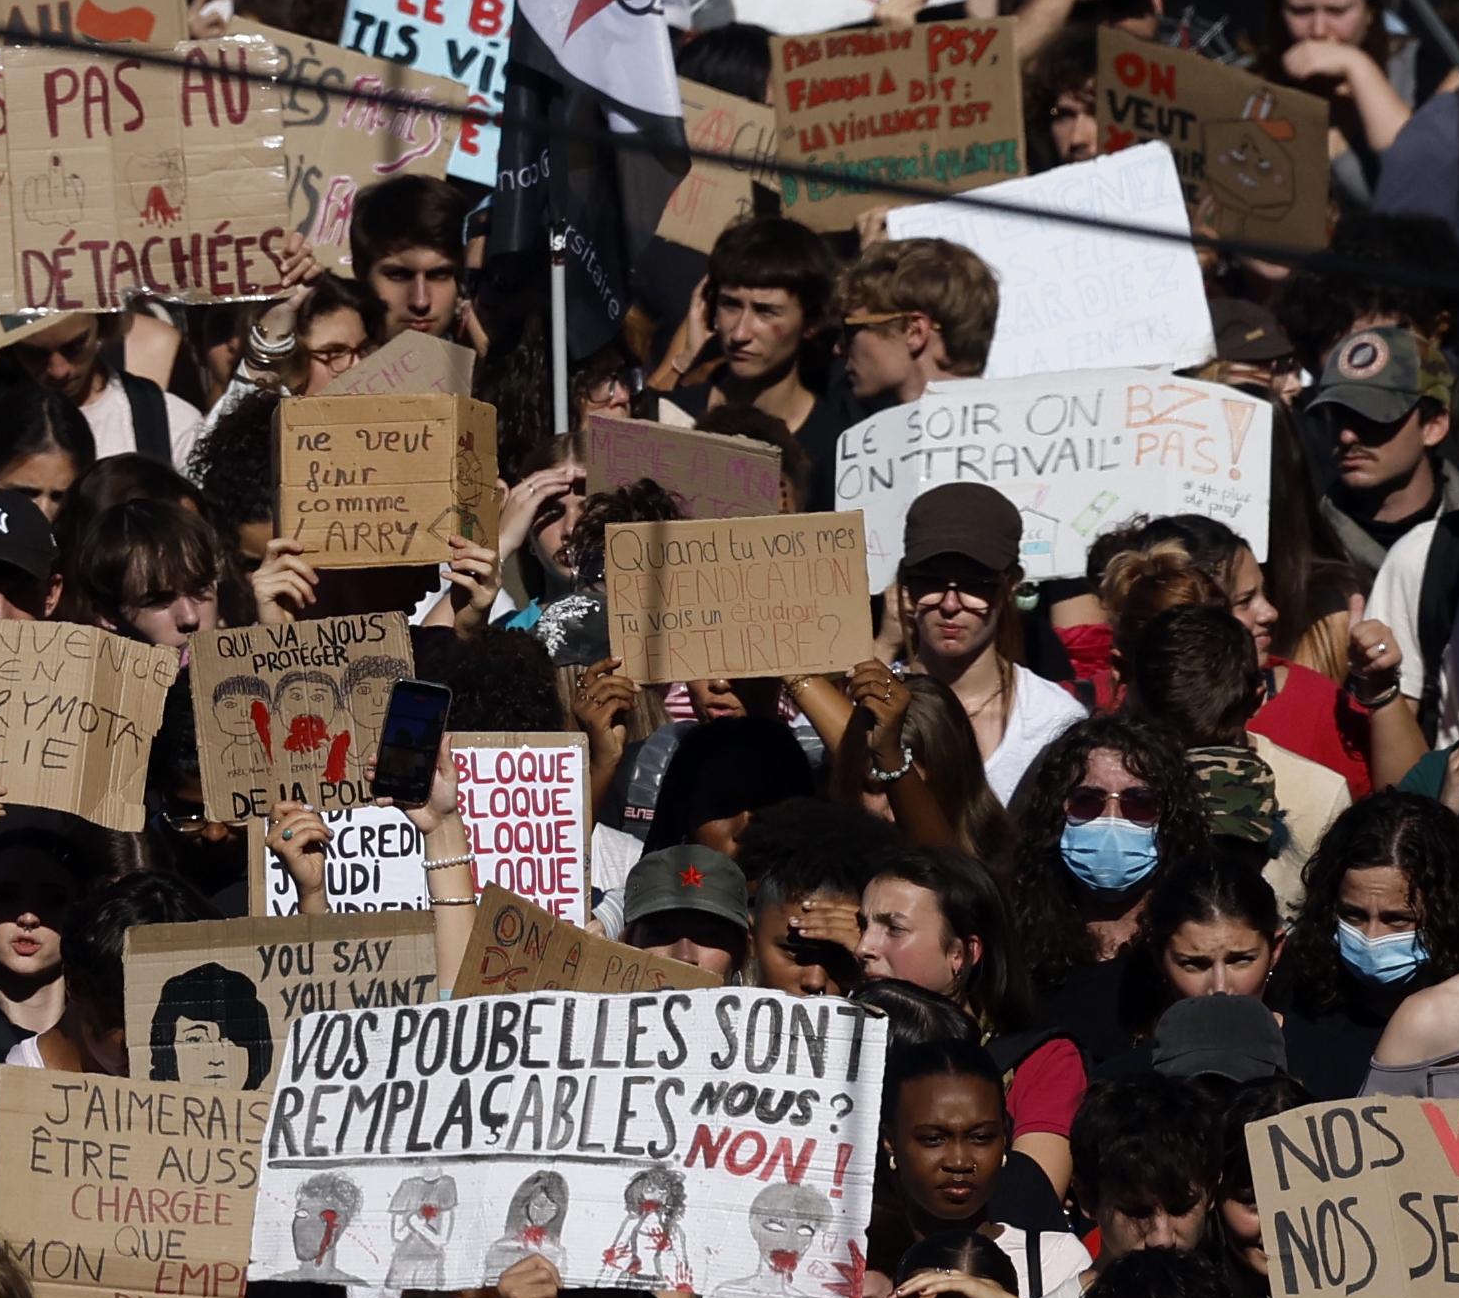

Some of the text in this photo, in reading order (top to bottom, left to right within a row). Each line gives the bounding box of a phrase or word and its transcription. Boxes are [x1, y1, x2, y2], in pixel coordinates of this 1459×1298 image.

[355, 11, 418, 62] ILS
[44, 59, 146, 139] PAS
[1112, 53, 1178, 100] ON
[1106, 91, 1199, 143] VEUT
[21, 220, 286, 312] DÉTACHÉES
[907, 389, 1104, 445] SOIR ON
[609, 527, 856, 573] Quand tu vois mes
[613, 556, 852, 611] REVENDICATION
[251, 641, 350, 674] PROTÉGER
[266, 614, 387, 650] VA NOUS
[455, 749, 576, 787] BLOQUE
[231, 788, 268, 820] DE
[256, 938, 393, 980] YOU SAY
[291, 994, 866, 1085] VOS POUBELLES SONT
[271, 1075, 687, 1160] REMPLAÇABLES
[1267, 1103, 1407, 1192] NOS
[71, 1183, 234, 1226] CHARGÉE
[1274, 1196, 1378, 1297] NOS
